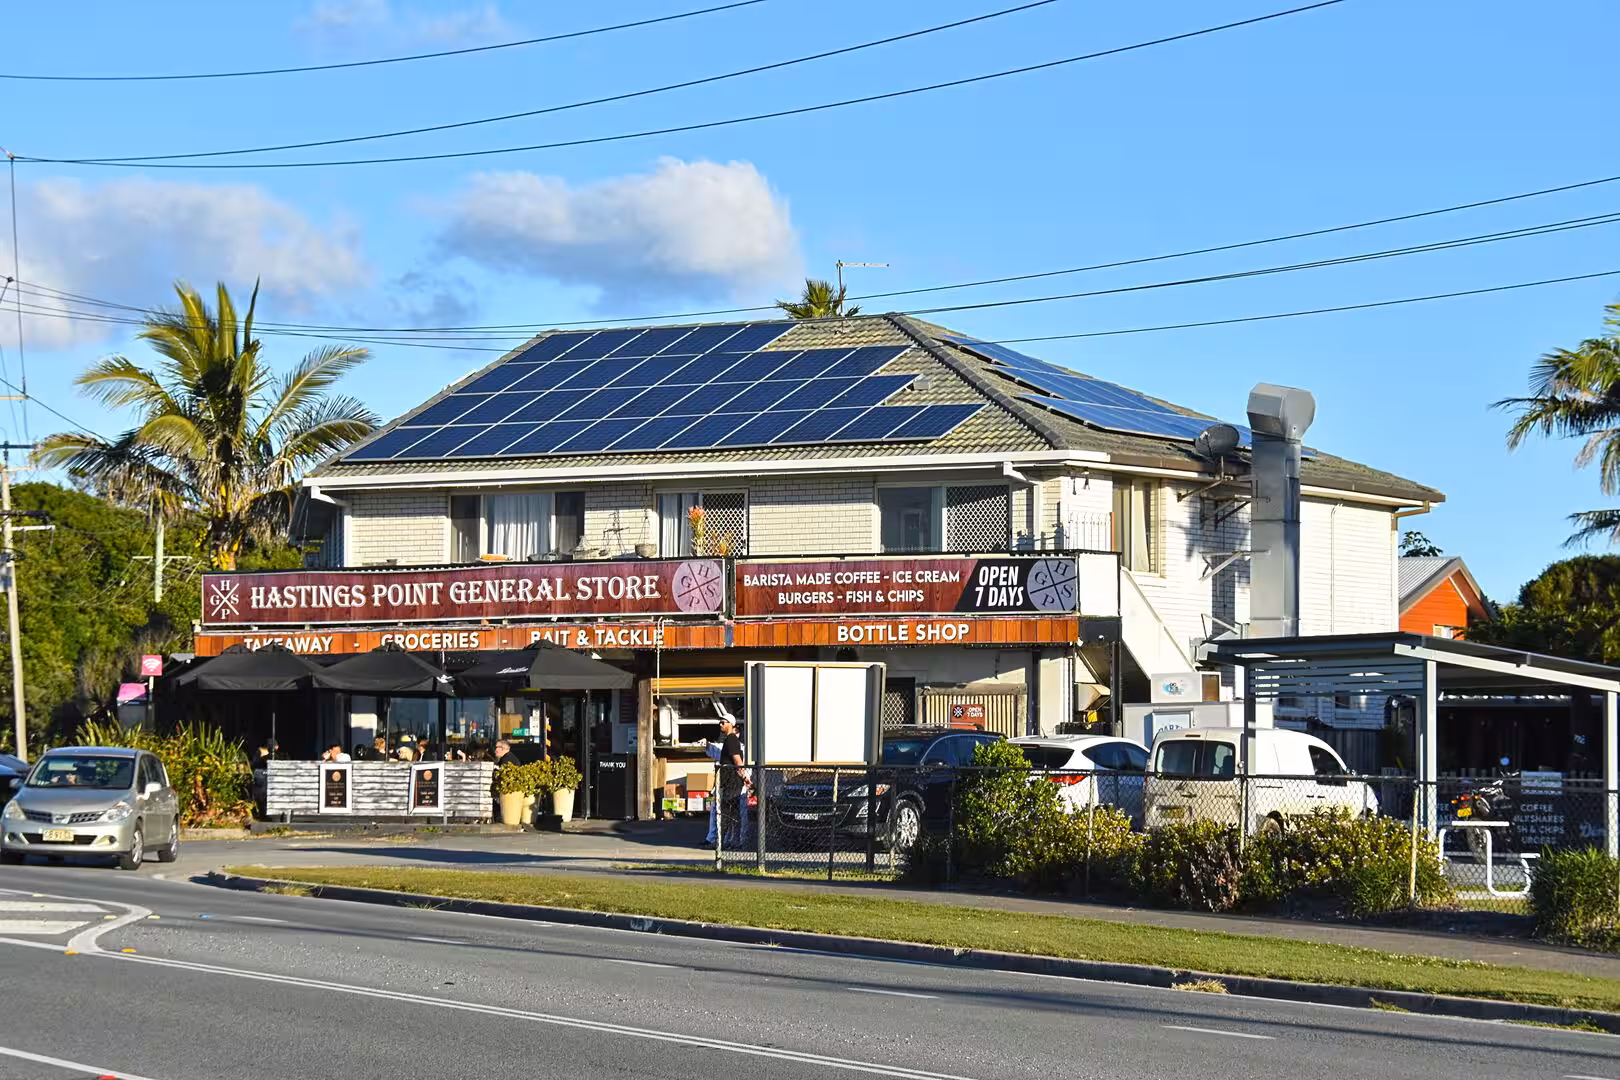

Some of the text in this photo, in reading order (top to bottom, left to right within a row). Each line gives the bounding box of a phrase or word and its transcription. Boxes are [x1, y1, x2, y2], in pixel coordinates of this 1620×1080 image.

[743, 573, 793, 587] BARISTA
[796, 572, 832, 585] MADE
[834, 571, 881, 584] COFFEE
[892, 570, 912, 583] ICE
[915, 570, 960, 583] CREAM
[978, 566, 1019, 586] OPEN
[250, 575, 661, 609] HASTINGS POINT GENERAL STORE
[778, 591, 834, 604] BURGERS
[846, 590, 872, 603] FISH
[875, 590, 885, 602] &
[887, 589, 924, 602] CHIPS
[975, 586, 1024, 607] 7 DAYS
[381, 632, 479, 649] GROCERIES
[576, 630, 589, 646] &
[595, 629, 663, 645] TACKLE
[837, 623, 970, 642] BOTTLE SHOP
[599, 761, 626, 769] THANK YOU
